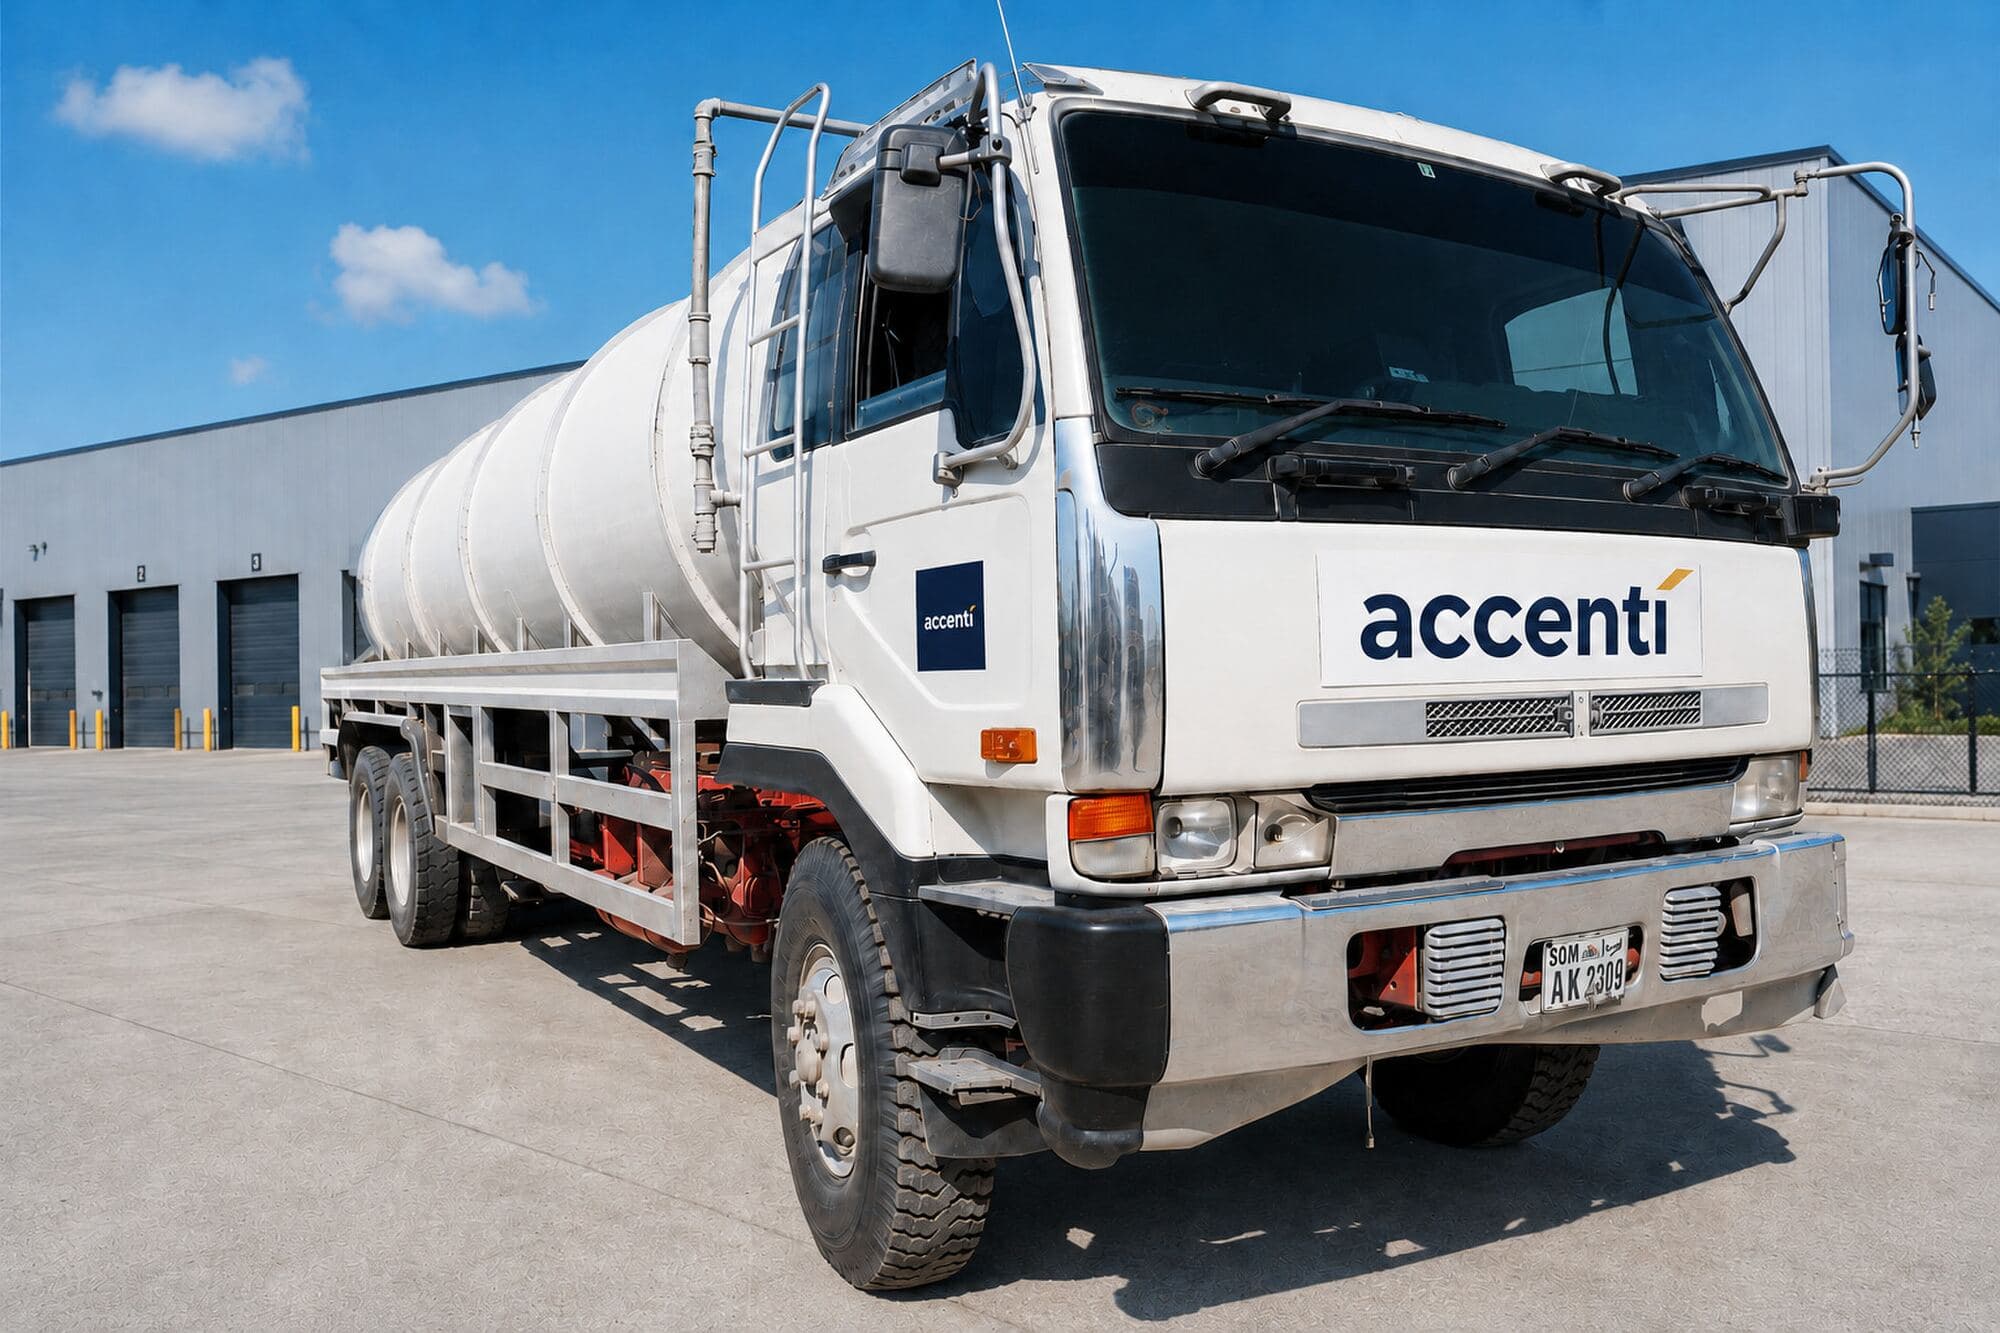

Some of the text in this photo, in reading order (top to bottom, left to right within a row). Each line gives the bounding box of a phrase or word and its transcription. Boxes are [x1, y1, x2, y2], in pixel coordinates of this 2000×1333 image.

[252, 555, 260, 570] 3
[1549, 943, 1580, 967] SOM
[1550, 958, 1624, 1006] AK 2309
